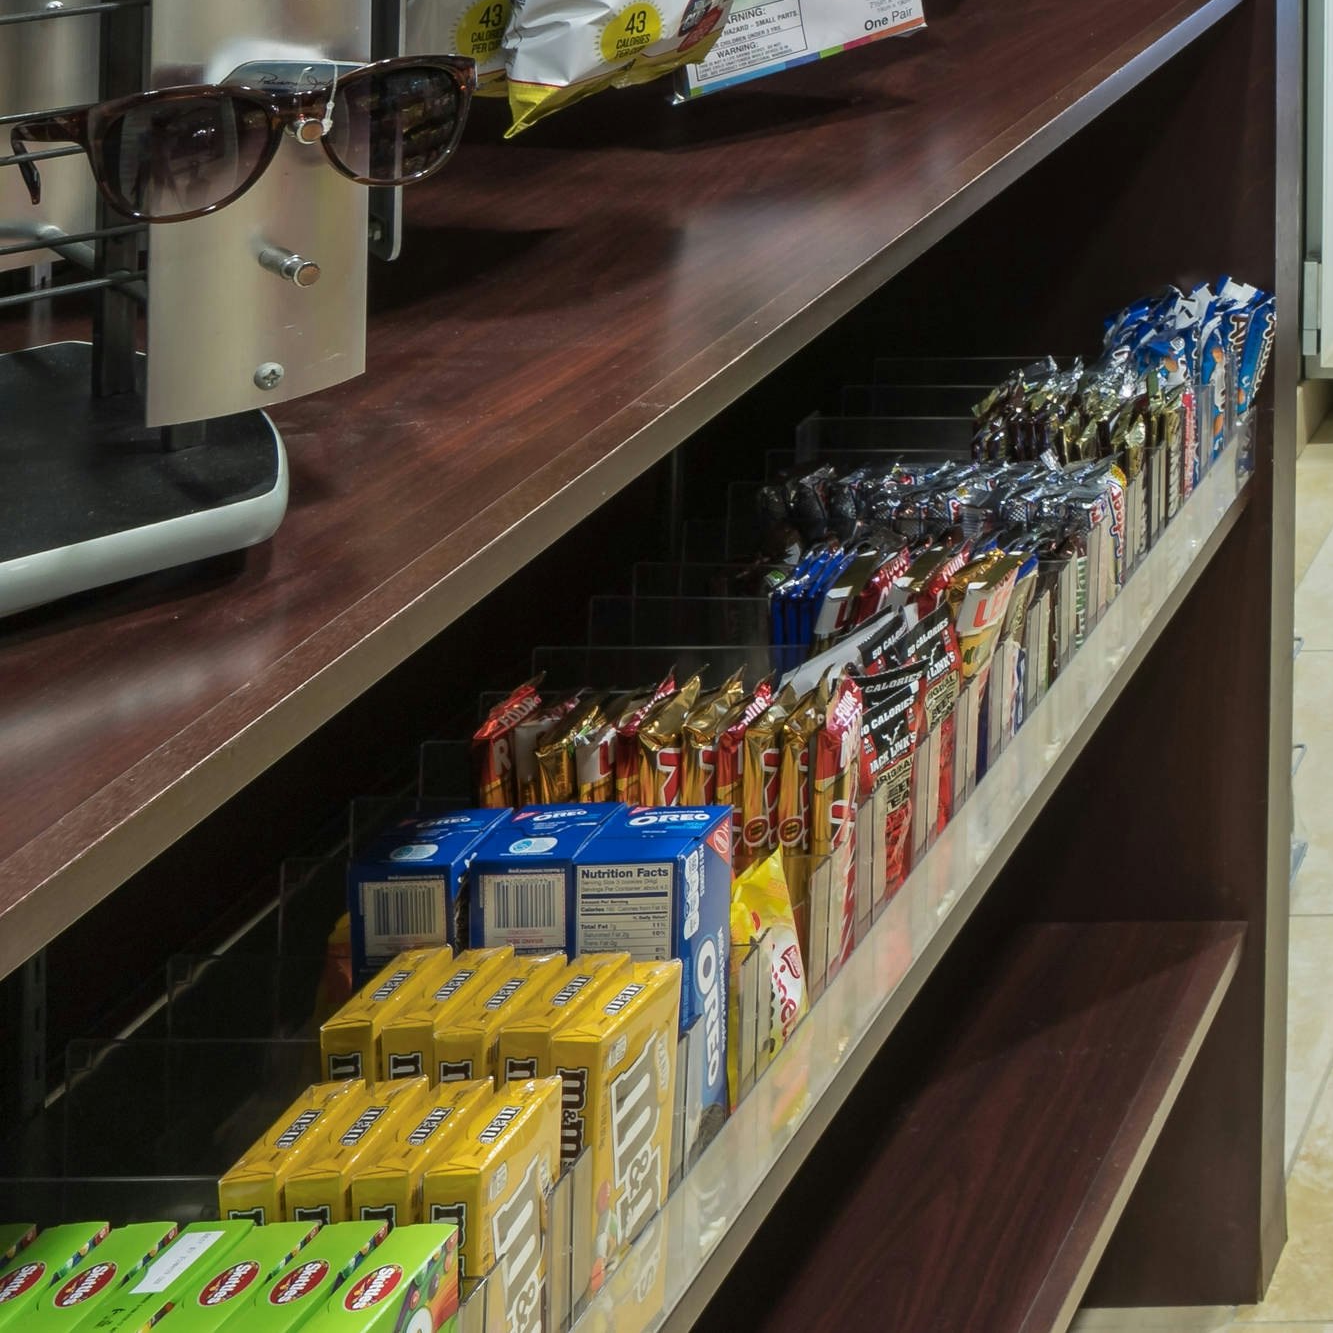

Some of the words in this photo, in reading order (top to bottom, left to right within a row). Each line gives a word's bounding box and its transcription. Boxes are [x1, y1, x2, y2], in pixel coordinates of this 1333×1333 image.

[479, 4, 502, 28] 43
[624, 10, 647, 34] 43
[723, 23, 749, 37] HAZARD
[755, 17, 776, 28] SMALL
[863, 16, 889, 32] One
[891, 7, 914, 23] Pair
[471, 41, 487, 54] PER
[616, 34, 650, 50] CALORIES
[716, 42, 759, 59] WARNING:
[719, 35, 746, 47] CHILDREN
[747, 31, 765, 42] UNDER
[916, 617, 949, 649] CALORIES
[870, 695, 914, 730] CALORIES
[889, 731, 917, 758] LINK'S
[533, 808, 588, 824] OREO
[629, 811, 711, 827] OREO
[581, 868, 634, 880] Nutrition
[636, 867, 669, 878] Facts
[695, 938, 726, 1090] OREO
[207, 1262, 252, 1306] Skittles
[277, 1261, 321, 1305] Skittles
[351, 1264, 395, 1310] Skittles
